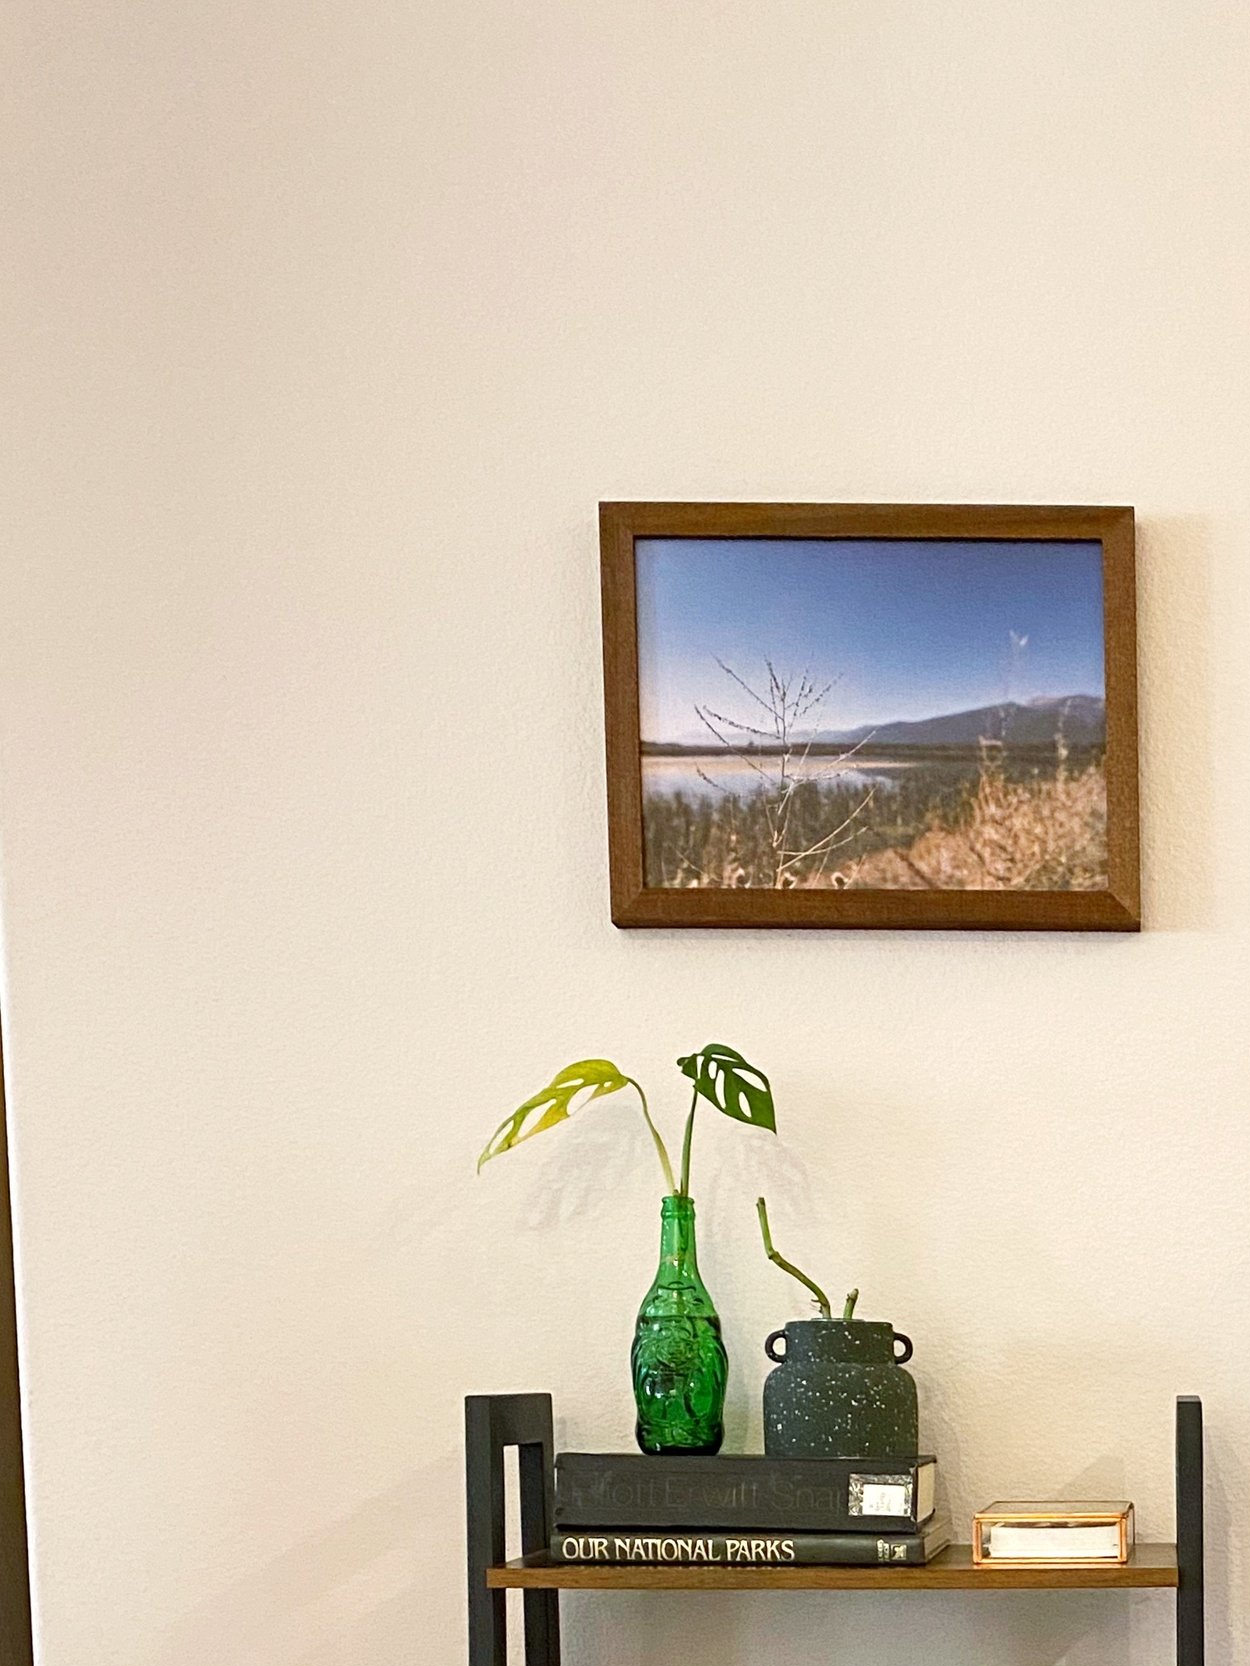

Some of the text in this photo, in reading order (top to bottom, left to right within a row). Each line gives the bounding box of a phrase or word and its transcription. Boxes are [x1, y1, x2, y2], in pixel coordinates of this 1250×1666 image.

[562, 1537, 795, 1562] OUR NATIONAL PARKS
